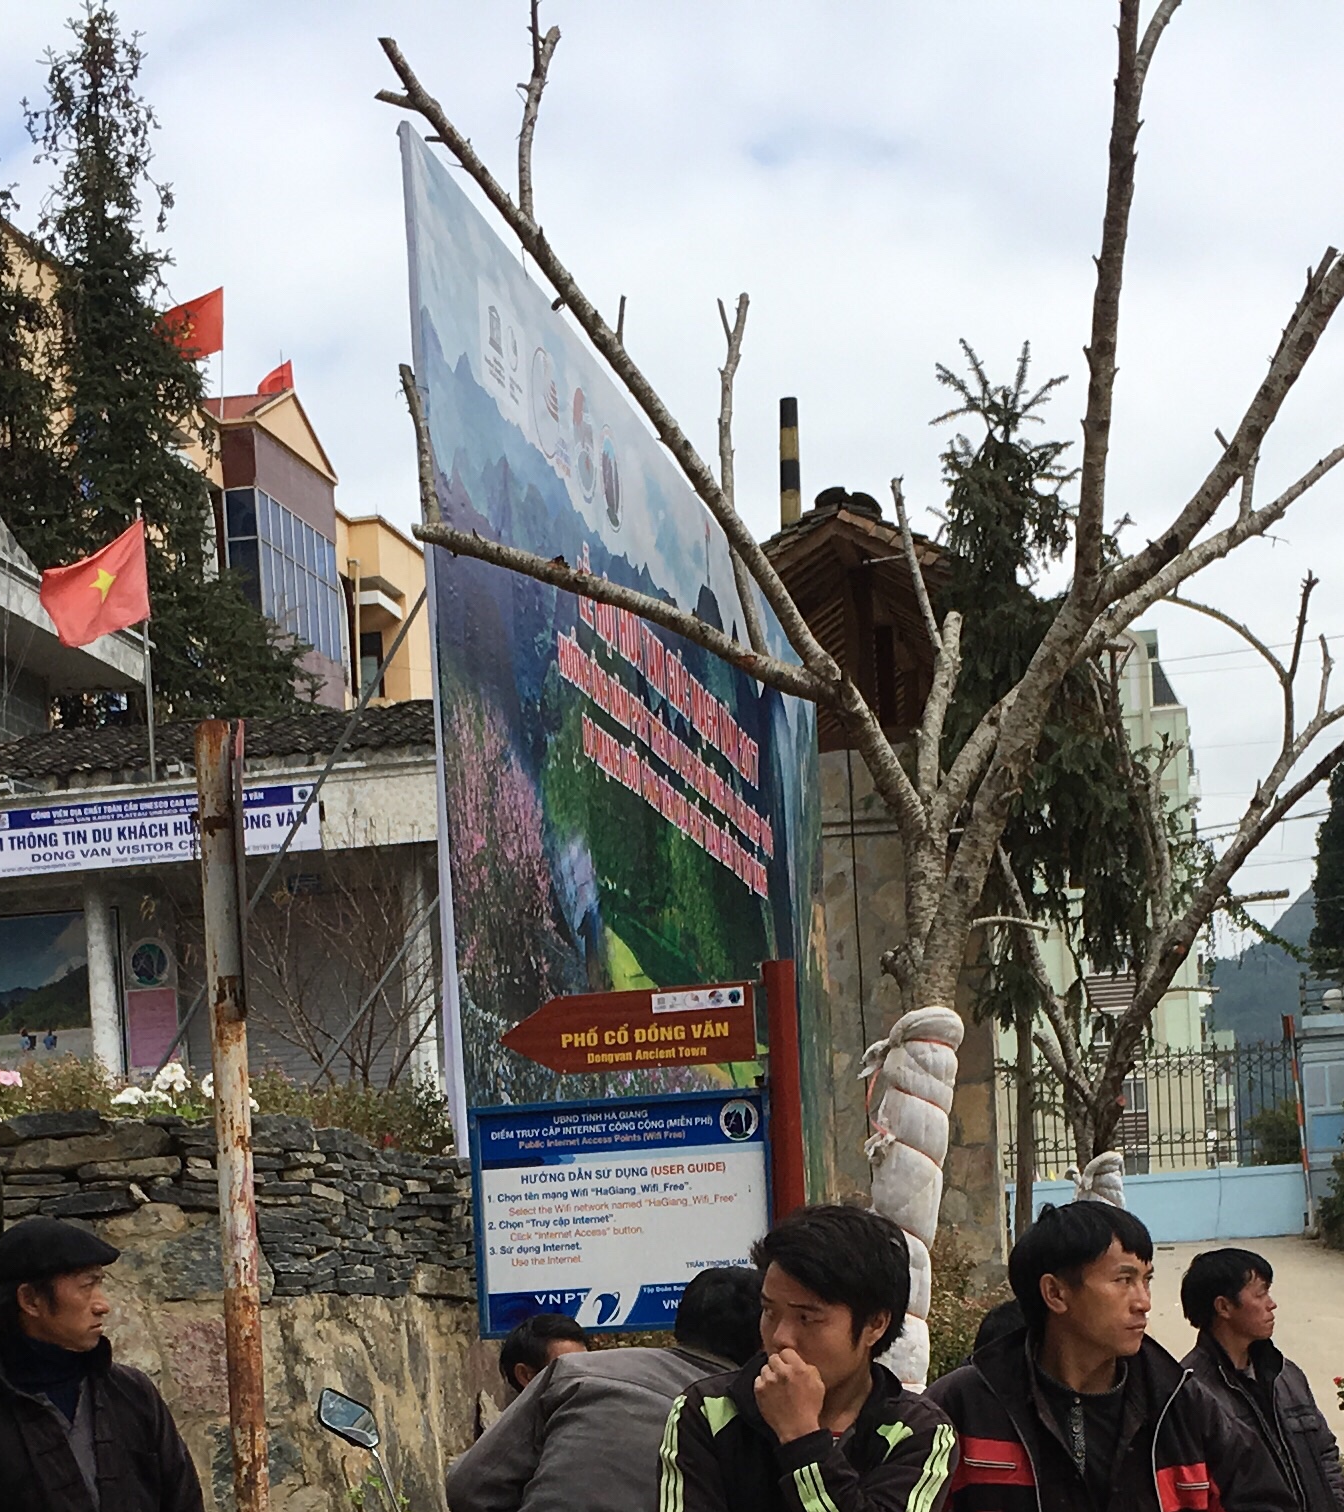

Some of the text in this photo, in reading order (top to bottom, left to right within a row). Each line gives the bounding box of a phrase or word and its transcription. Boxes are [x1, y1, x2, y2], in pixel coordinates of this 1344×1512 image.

[139, 800, 168, 811] UNESCO
[8, 832, 58, 850] THÔNG
[62, 829, 87, 845] TIN
[92, 827, 113, 843] DU
[117, 820, 172, 841] KHÁCH
[276, 807, 308, 826] VĂN
[31, 850, 75, 863] DONG
[80, 847, 111, 859] VAN
[116, 842, 174, 855] VISITOR
[561, 1019, 729, 1048] PHỐ CỔ ĐỒNG VĂN
[587, 1046, 707, 1064] Dongvan Ancient Town
[553, 1114, 580, 1124] UBND
[618, 1109, 649, 1120] GIANG
[490, 1127, 514, 1140] ĐIỂM
[516, 1128, 540, 1139] TRUY
[562, 1123, 606, 1135] INTERNET
[608, 1119, 636, 1132] CÔNG
[637, 1118, 665, 1131] CỘNG
[666, 1115, 693, 1129] (MIỄN
[519, 1140, 545, 1149] Public
[547, 1138, 580, 1148] Internet
[581, 1136, 612, 1145] Access
[614, 1133, 641, 1143] Points
[664, 1130, 686, 1140] Free)
[521, 1161, 726, 1185] HƯỚNG DẪN SỬ DỤNG (USER GUIDE)
[497, 1192, 522, 1203] Chọn
[524, 1191, 539, 1201] tên
[542, 1189, 568, 1201] mạng
[570, 1187, 589, 1198] Wifi
[509, 1199, 642, 1216] Select the Wifi network named
[488, 1222, 496, 1230] 2.
[499, 1219, 523, 1230] Chọn
[553, 1216, 570, 1228] cập
[510, 1231, 531, 1241] Click
[489, 1247, 497, 1255] 3.
[517, 1244, 541, 1255] dụng
[543, 1242, 582, 1252] Internet.
[511, 1258, 528, 1267] Use
[531, 1256, 545, 1266] the
[534, 1292, 588, 1305] VNPT
